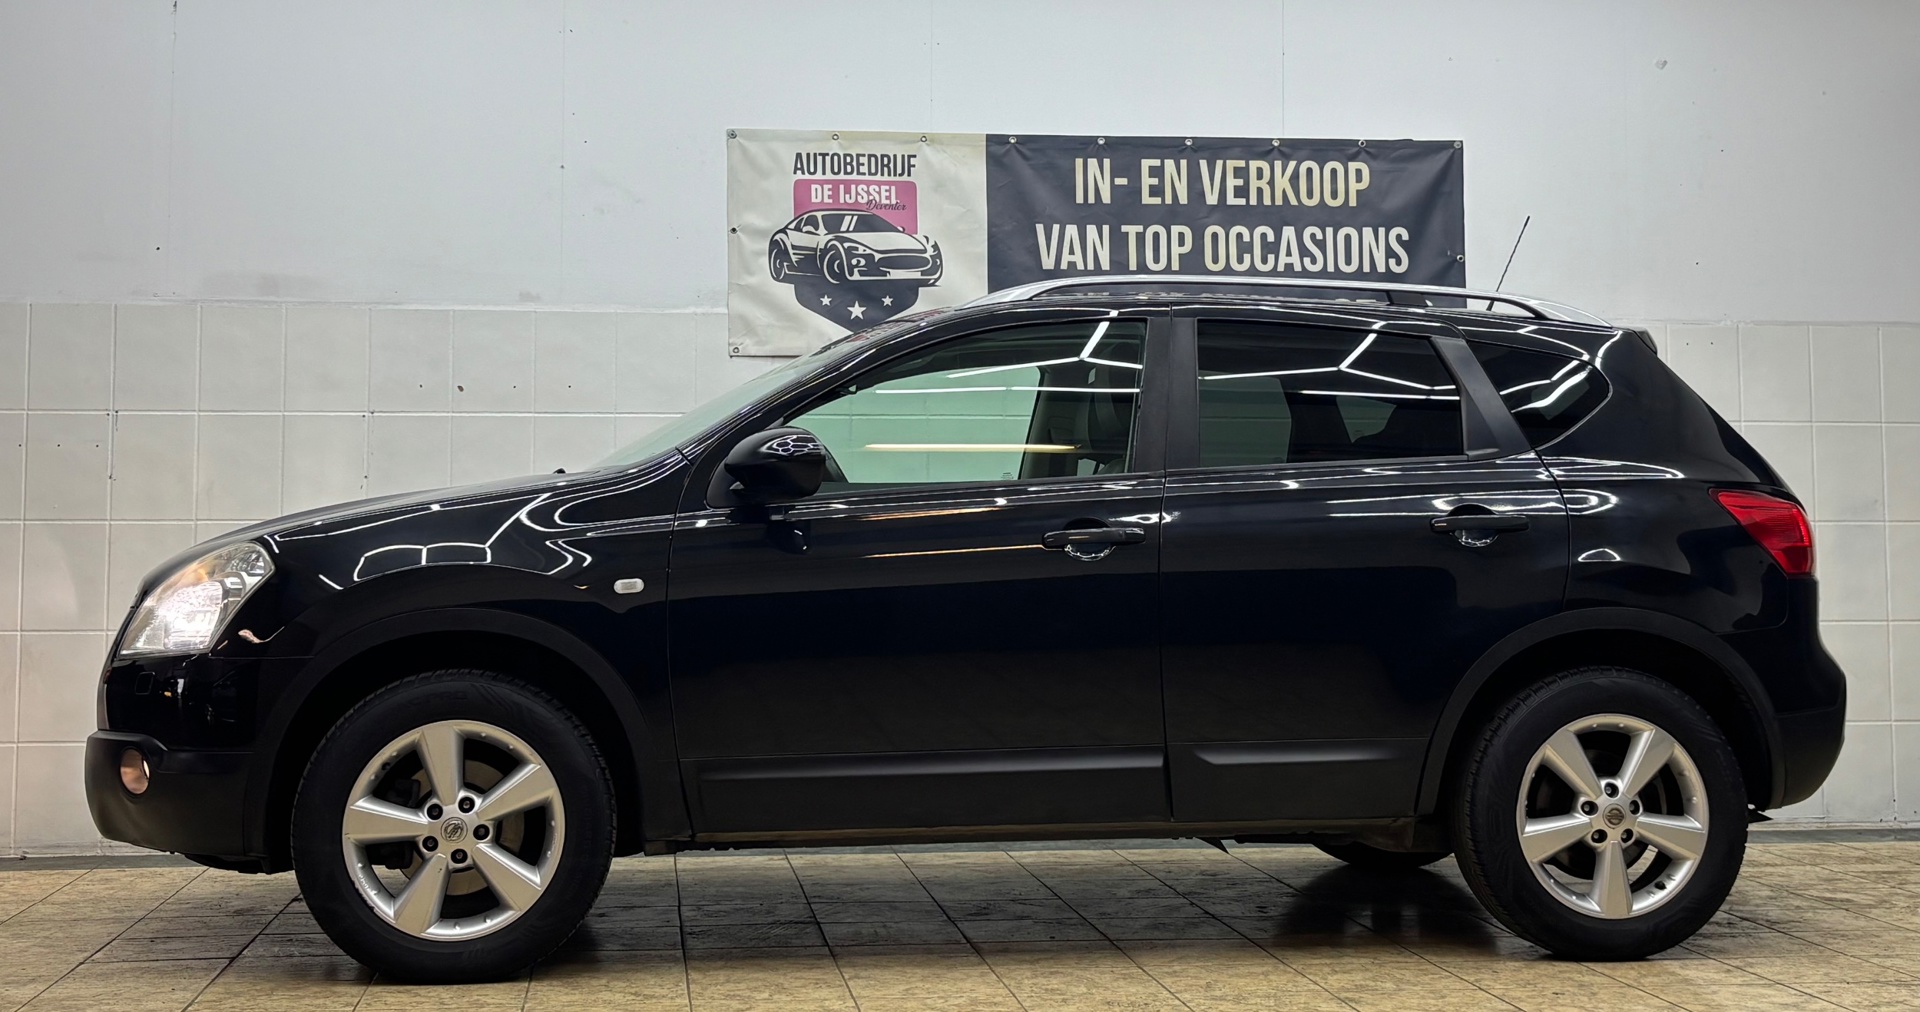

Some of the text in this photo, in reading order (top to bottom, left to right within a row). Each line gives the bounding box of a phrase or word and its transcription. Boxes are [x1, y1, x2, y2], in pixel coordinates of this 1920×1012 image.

[793, 152, 917, 177] AUTOBEDRIJF
[811, 184, 900, 205] DE IJSSEL
[1074, 157, 1371, 207] IN- EN VERKOOP
[866, 199, 907, 211] Deventer
[1035, 223, 1410, 273] VAN TOP OCCASIONS
